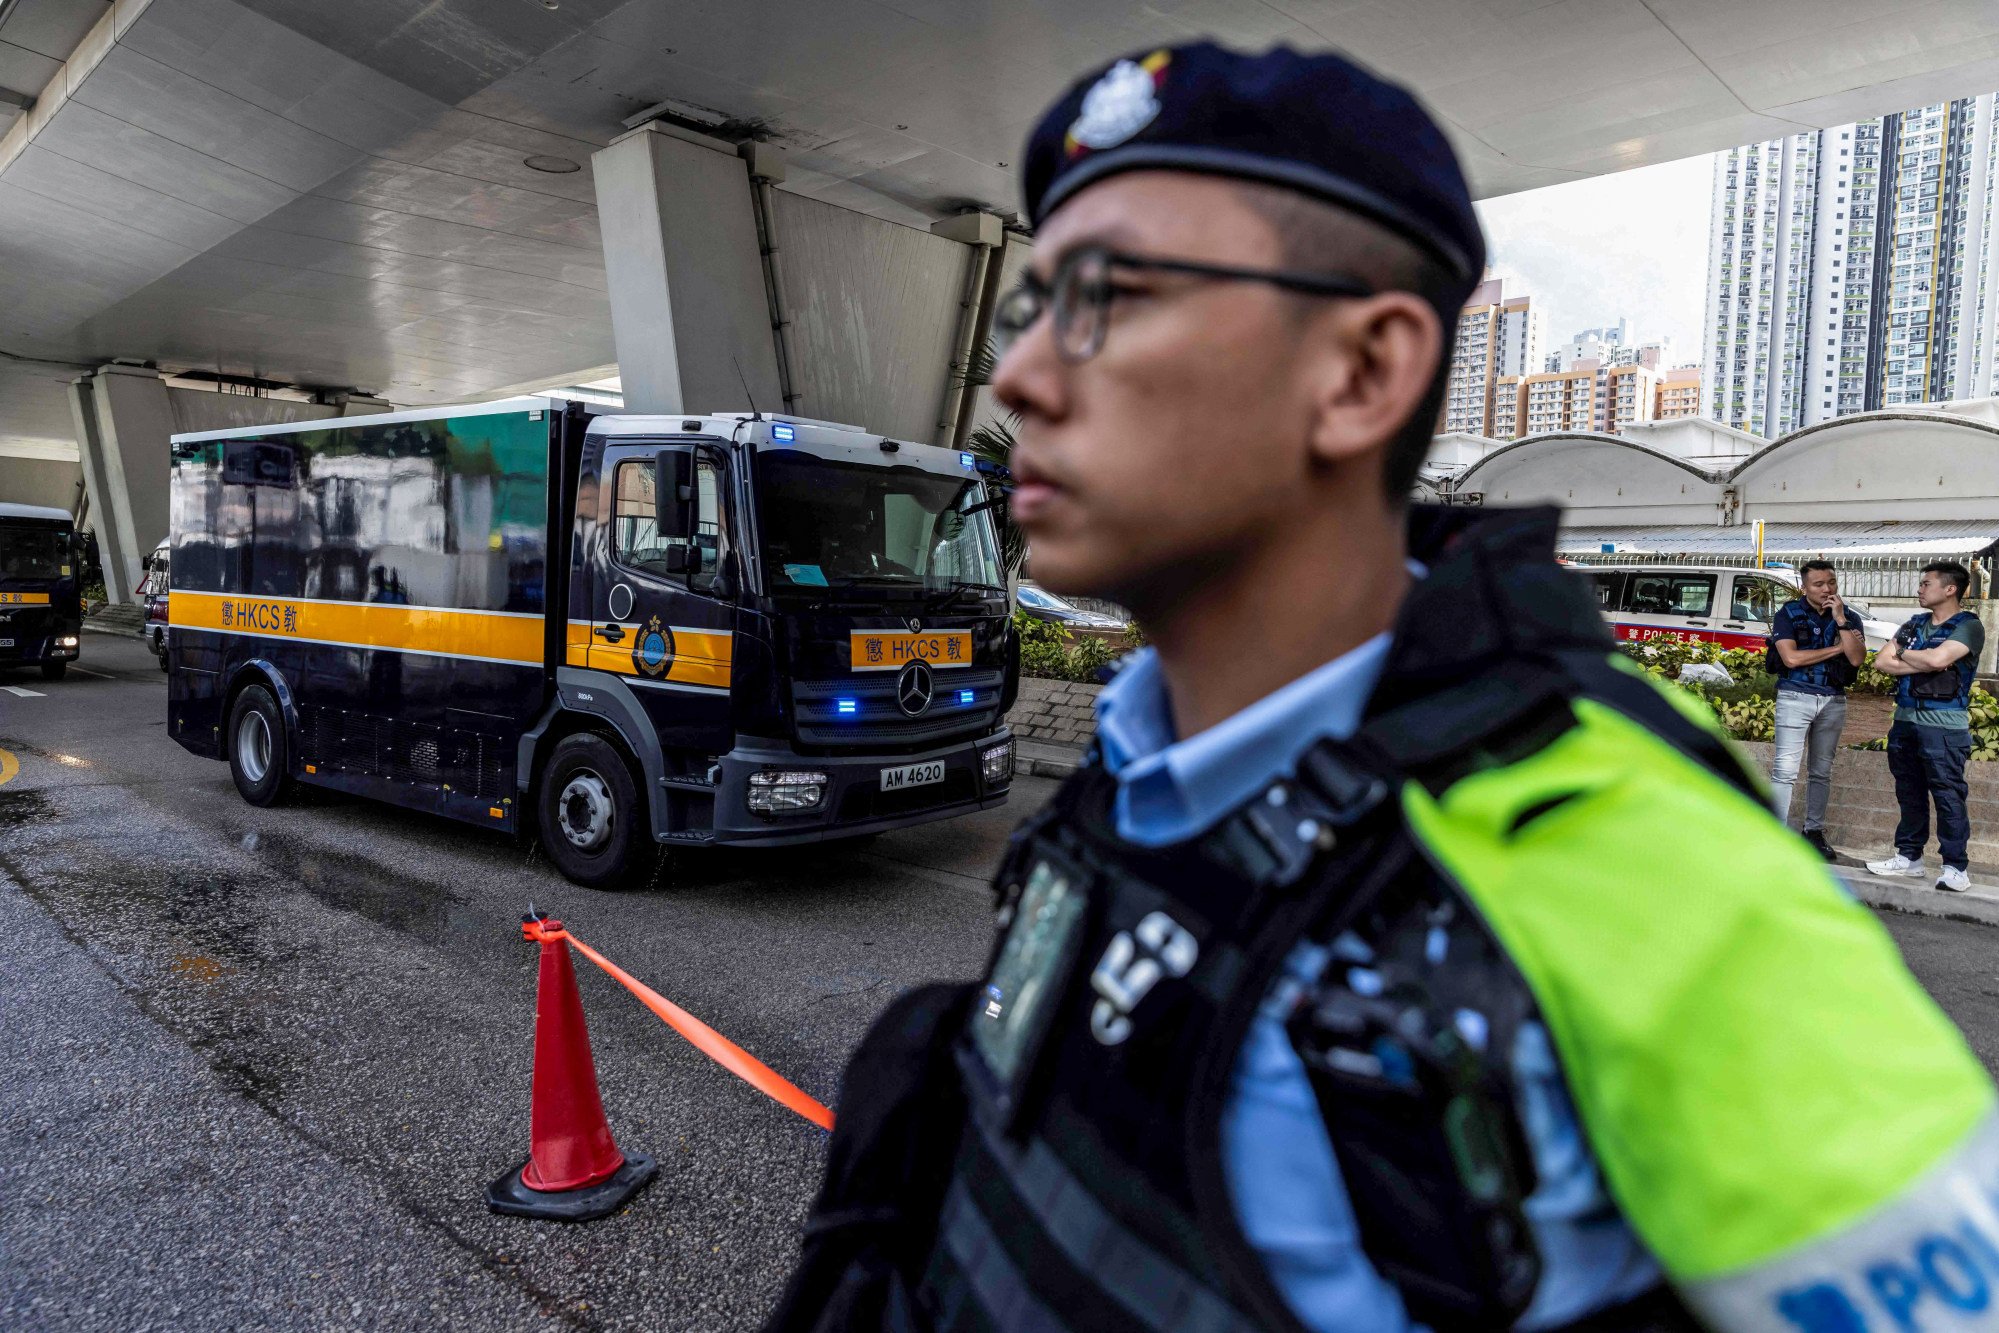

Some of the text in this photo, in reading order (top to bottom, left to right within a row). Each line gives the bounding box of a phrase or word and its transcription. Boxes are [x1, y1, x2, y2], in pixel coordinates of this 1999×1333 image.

[237, 602, 280, 630] HKCS
[865, 637, 883, 662] 懲
[892, 639, 940, 659] HKCS
[885, 764, 941, 788] AM 4620
